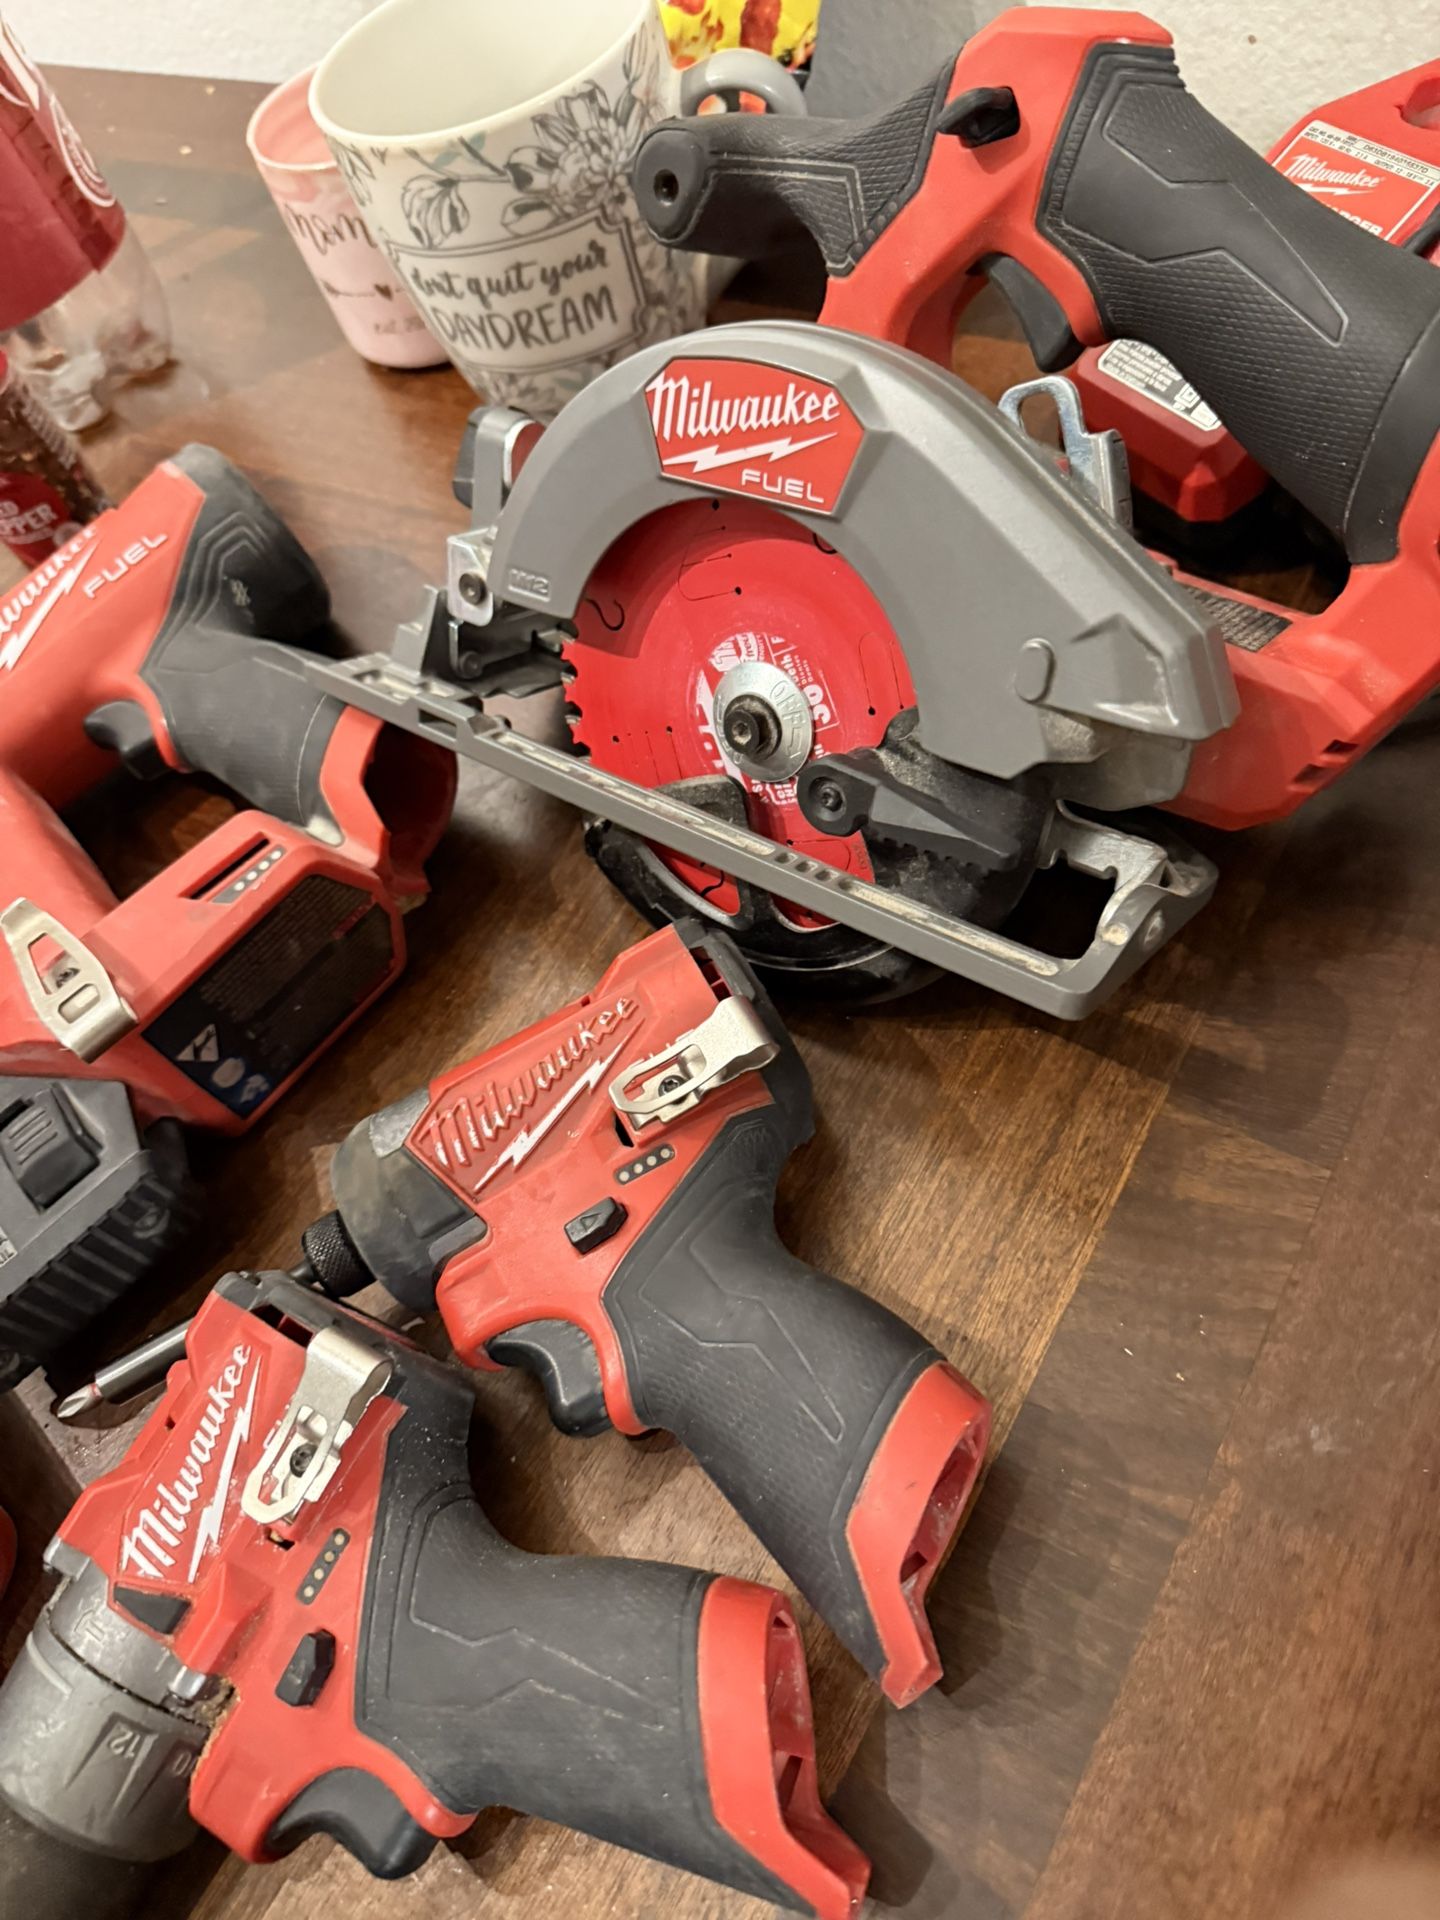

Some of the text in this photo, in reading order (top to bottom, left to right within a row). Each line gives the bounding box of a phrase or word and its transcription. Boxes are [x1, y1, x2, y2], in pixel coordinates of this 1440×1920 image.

[1283, 153, 1382, 188] Milwaukee
[466, 260, 537, 309] quit
[540, 239, 609, 296] your
[429, 285, 619, 351] DAYDREAM
[645, 371, 841, 443] Milwaukee
[741, 468, 825, 504] FUEL
[83, 533, 168, 599] FUEL
[418, 997, 640, 1172] Milwaukee
[121, 1344, 252, 1578] Milwaukee
